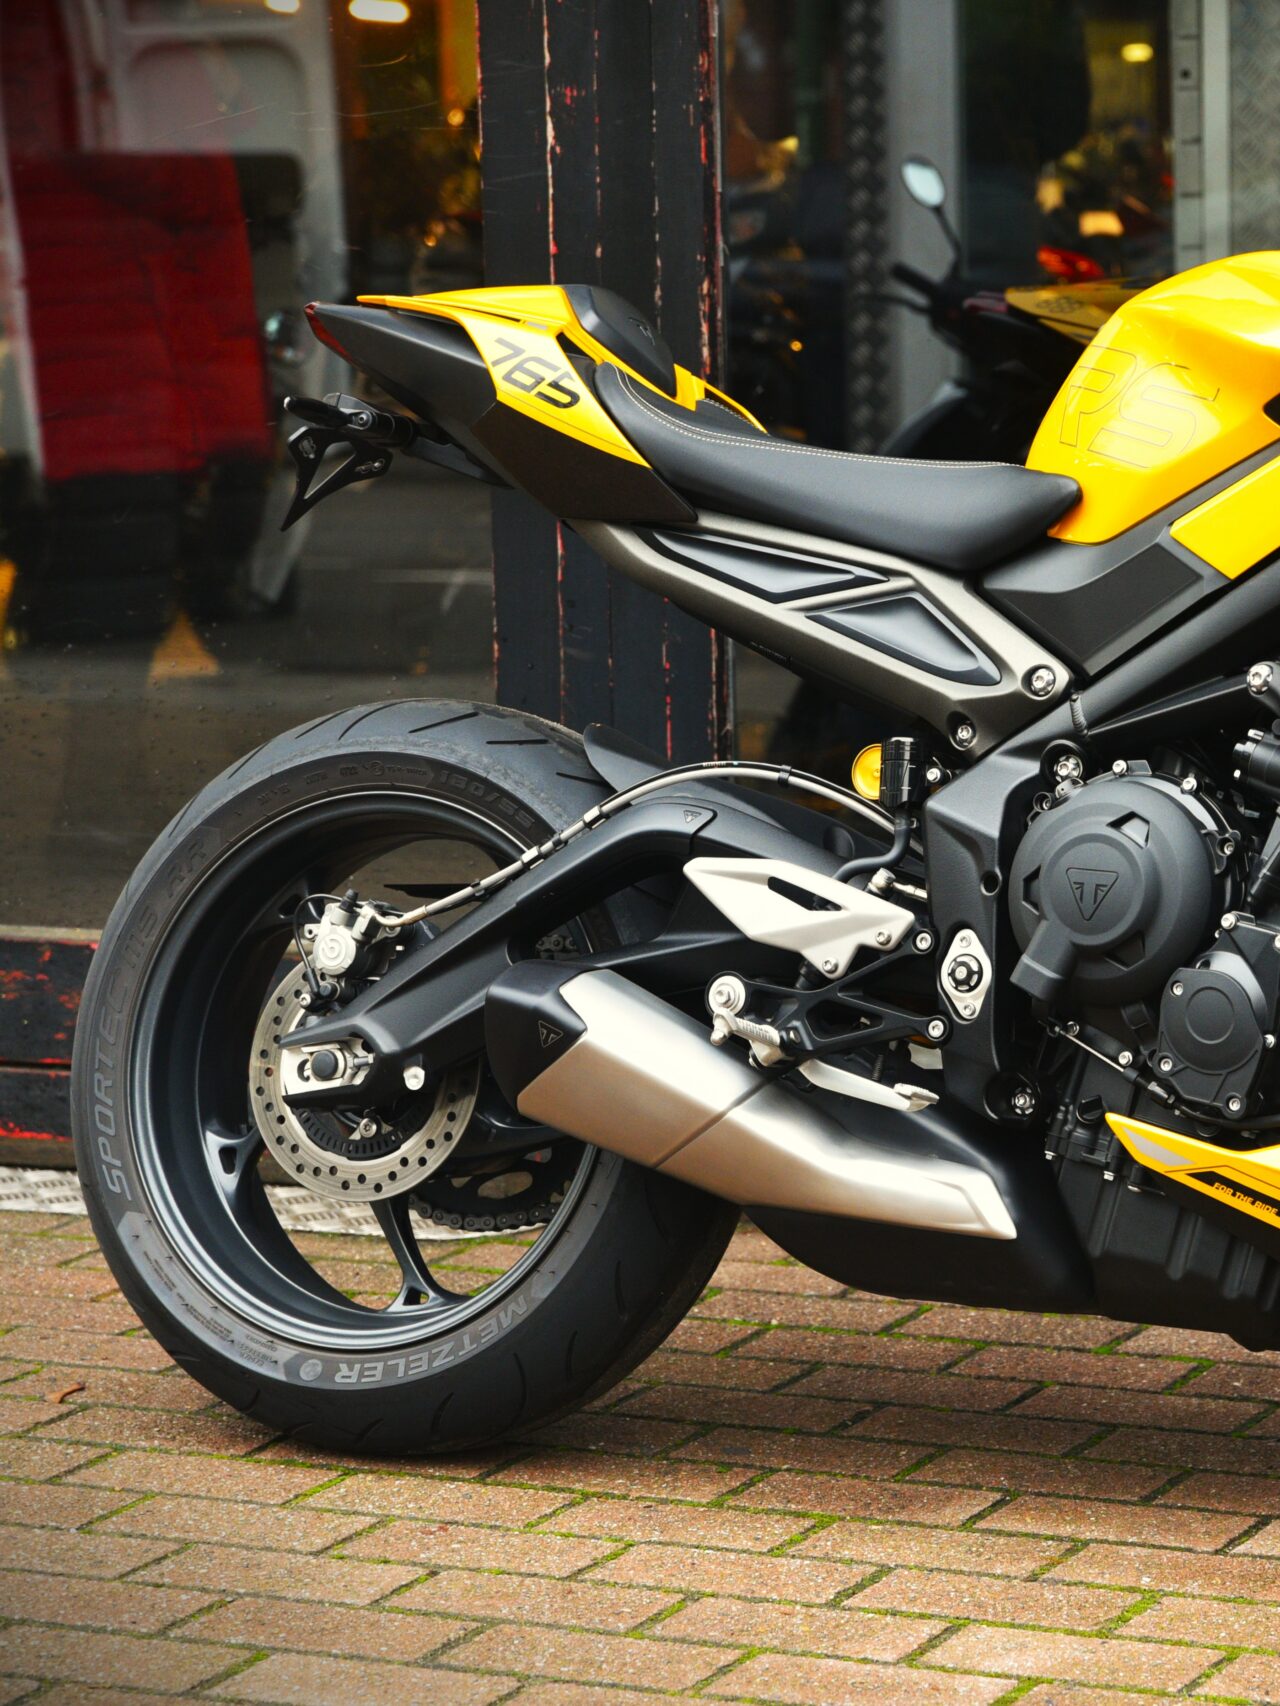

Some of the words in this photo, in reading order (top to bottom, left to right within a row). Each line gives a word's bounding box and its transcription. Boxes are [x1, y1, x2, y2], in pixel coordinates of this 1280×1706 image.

[491, 337, 580, 409] 765
[1060, 345, 1220, 468] RS
[1213, 1182, 1233, 1197] FOR
[1234, 1191, 1254, 1205] THE
[1254, 1200, 1278, 1215] RIDE
[334, 1295, 529, 1384] METZELER
